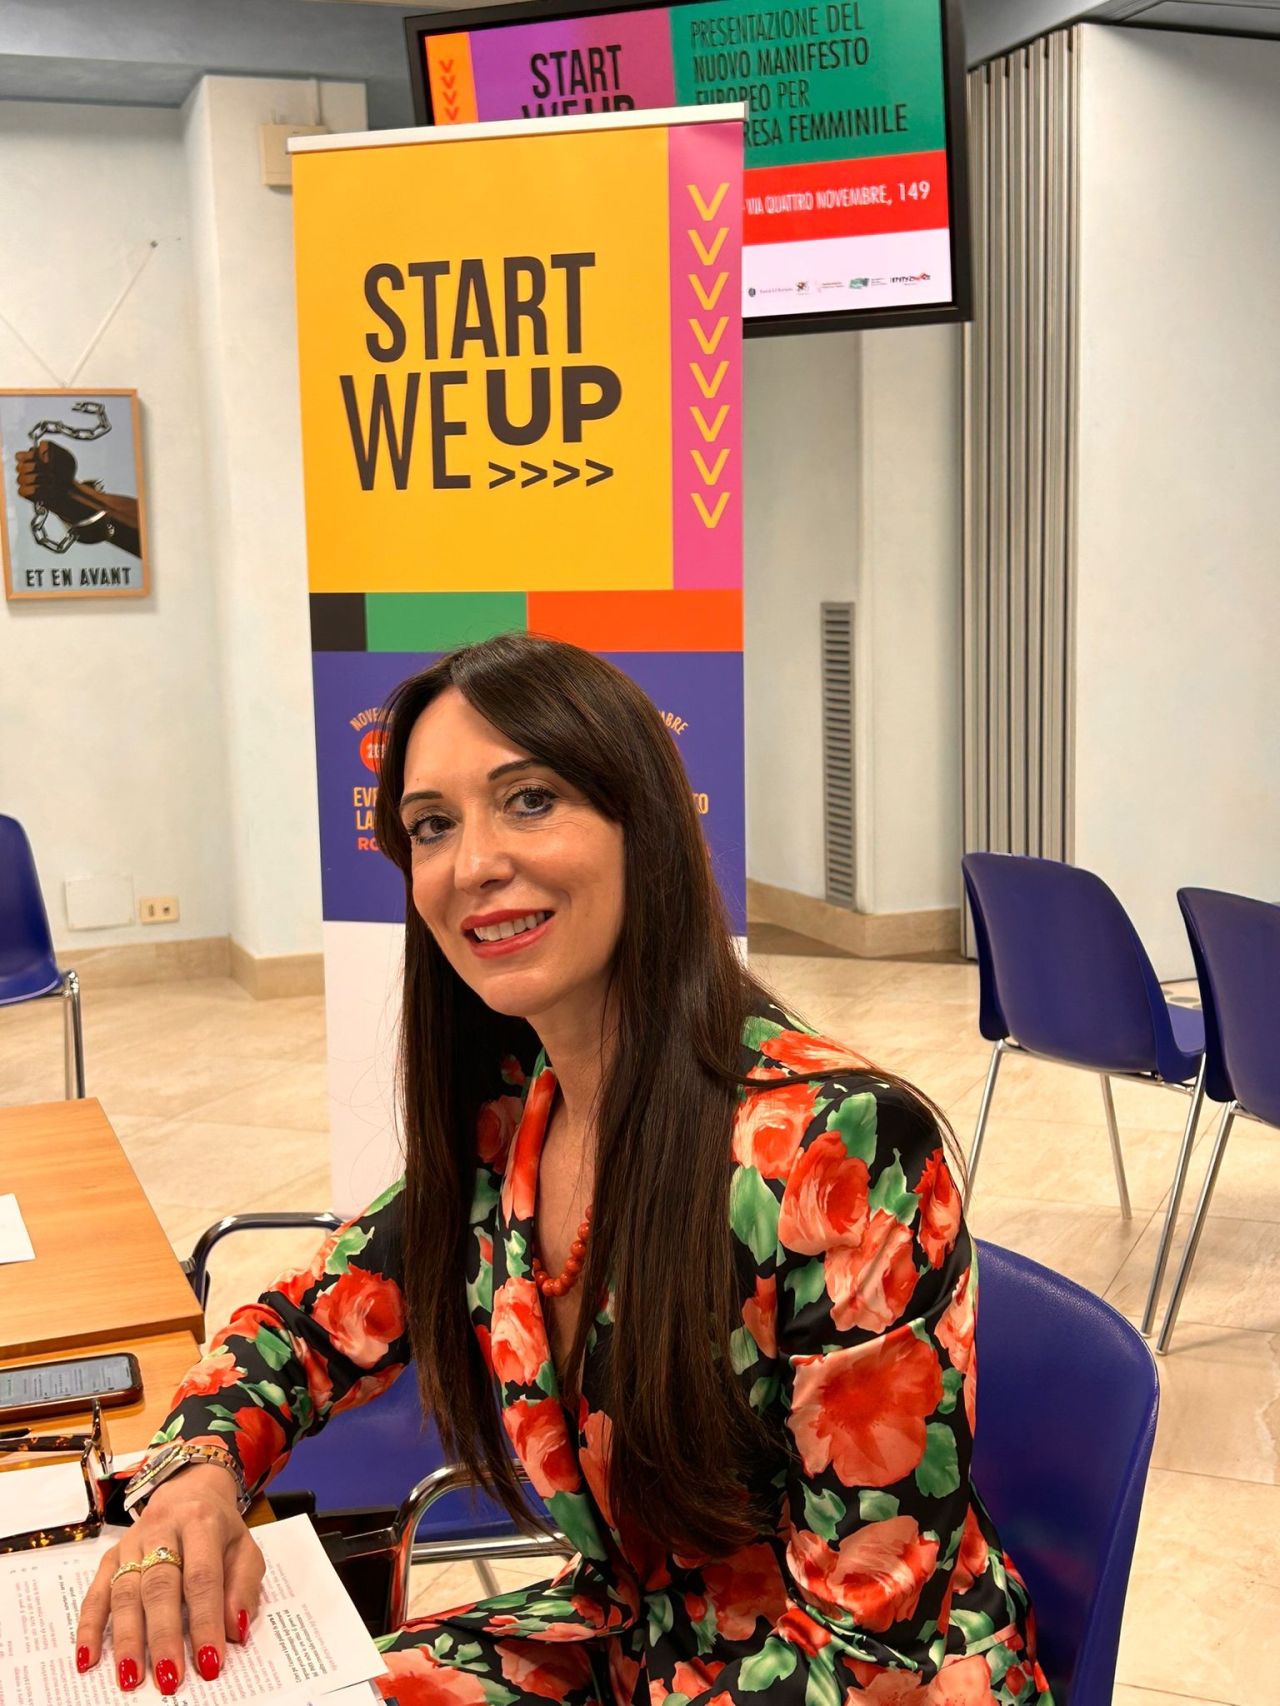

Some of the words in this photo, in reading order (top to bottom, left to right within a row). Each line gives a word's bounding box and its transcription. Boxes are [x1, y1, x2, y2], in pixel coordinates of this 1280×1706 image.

[691, 7, 819, 48] PRESENTAZIONE
[826, 3, 864, 33] DEL
[530, 44, 622, 99] START
[693, 50, 750, 83] NUOVO
[758, 37, 869, 76] MANIFESTO
[777, 79, 810, 108] PER
[744, 118, 782, 147] RESA
[789, 103, 908, 142] FEMMINILE
[745, 196, 765, 215] VIA
[765, 192, 813, 214] QUATTRO
[815, 184, 893, 209] NOVEMBRE,
[898, 180, 931, 202] 149
[363, 252, 596, 363] START
[26, 569, 44, 587] ET
[51, 568, 73, 587] EN
[80, 567, 132, 586] AVANT
